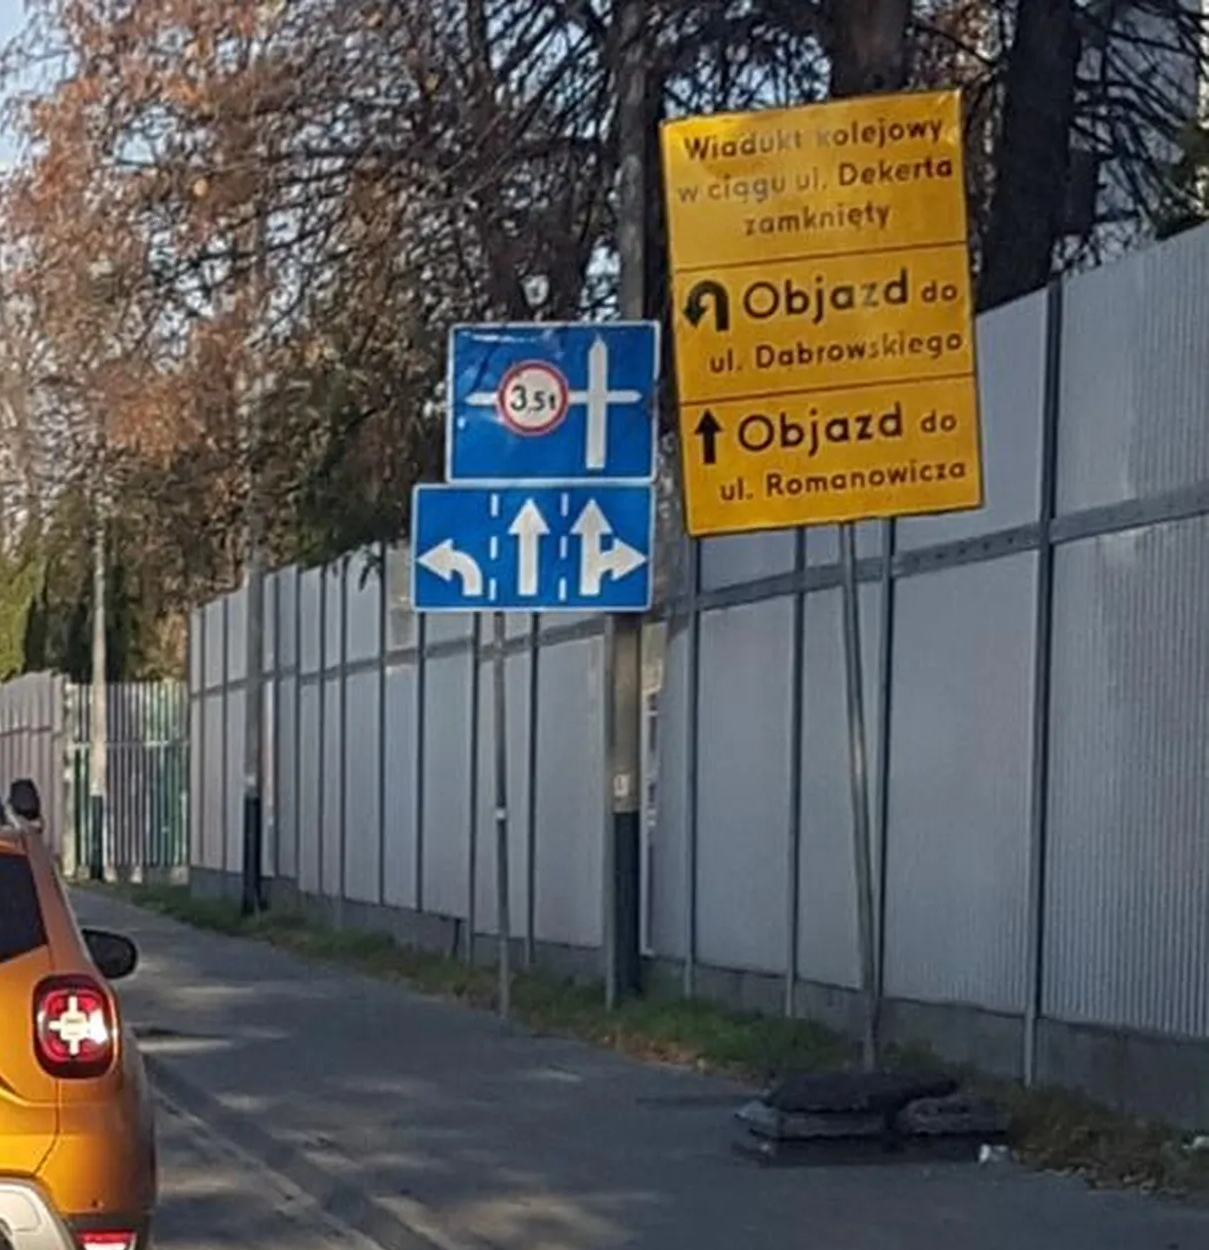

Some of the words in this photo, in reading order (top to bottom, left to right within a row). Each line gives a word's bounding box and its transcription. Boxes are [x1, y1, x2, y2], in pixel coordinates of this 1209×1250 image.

[684, 129, 803, 161] Wiadukt
[816, 117, 944, 148] kolejowy
[679, 186, 698, 203] w
[796, 167, 829, 191] ul.
[839, 158, 953, 187] Dekerta
[744, 203, 891, 236] zamknięty
[742, 268, 909, 325] Objazd
[921, 280, 959, 302] do
[709, 348, 743, 374] ul.
[738, 402, 903, 457] Objazd
[920, 410, 958, 434] do
[720, 477, 754, 502] ul.
[766, 460, 967, 498] Romanowicza
